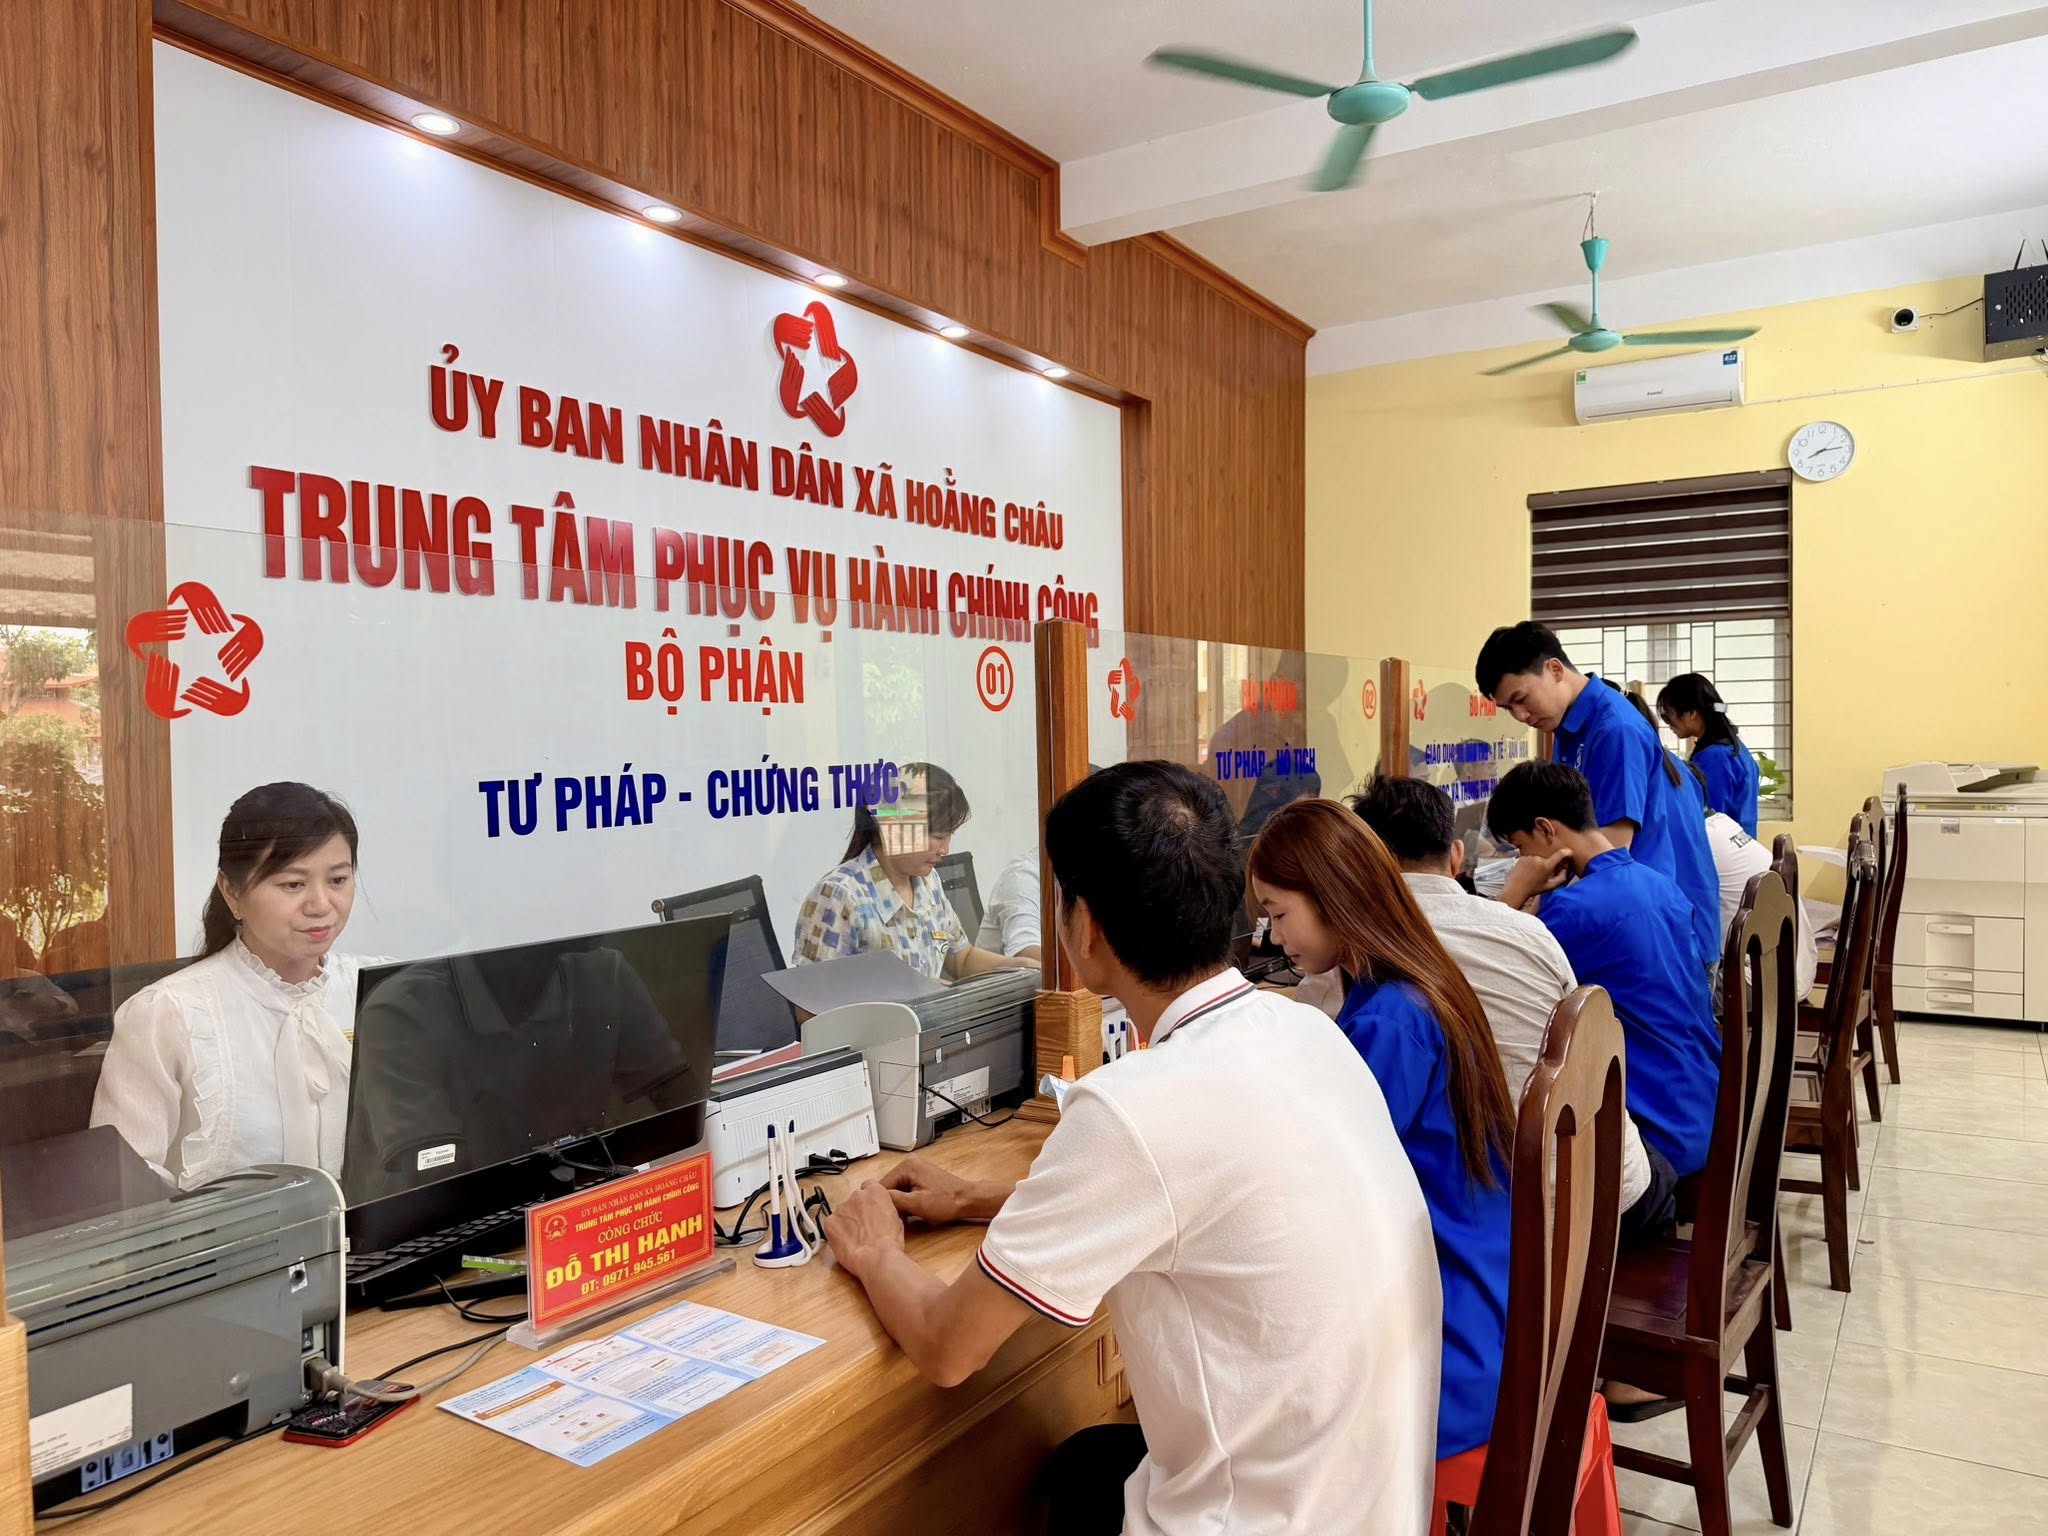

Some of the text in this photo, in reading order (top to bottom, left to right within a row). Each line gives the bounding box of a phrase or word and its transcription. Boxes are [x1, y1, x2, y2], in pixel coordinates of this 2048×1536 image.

[428, 343, 1064, 551] ỦY BAN NHÂN DÂN XÃ HOẰNG CHÂU
[248, 465, 495, 598] TRUNG
[511, 490, 637, 609] TÂM
[655, 526, 775, 637] PHỤC
[786, 547, 838, 642] VỤ
[848, 545, 940, 636] HÀNH
[948, 563, 1031, 643] CHÍNH
[624, 627, 804, 716] BỘ PHẬN
[985, 662, 1005, 695] 01
[1366, 689, 1374, 709] 02
[1216, 748, 1233, 780] TƯ
[1235, 744, 1266, 779] PHÁP
[1294, 748, 1316, 780] TỊCH
[478, 772, 543, 838] TƯ
[554, 763, 667, 832] PHÁP
[707, 754, 819, 819] CHỨNG
[828, 758, 899, 816] THỰC
[575, 1182, 700, 1232] TRUNG TÂM PHỤC VỤ HÀNH CHÍNH CÔNG
[592, 1203, 608, 1214] BAN
[633, 1210, 663, 1231] CHỨC
[545, 1213, 703, 1290] ĐỖ THỊ HẠNH
[580, 1248, 676, 1295] ĐT: 0971.945.561
